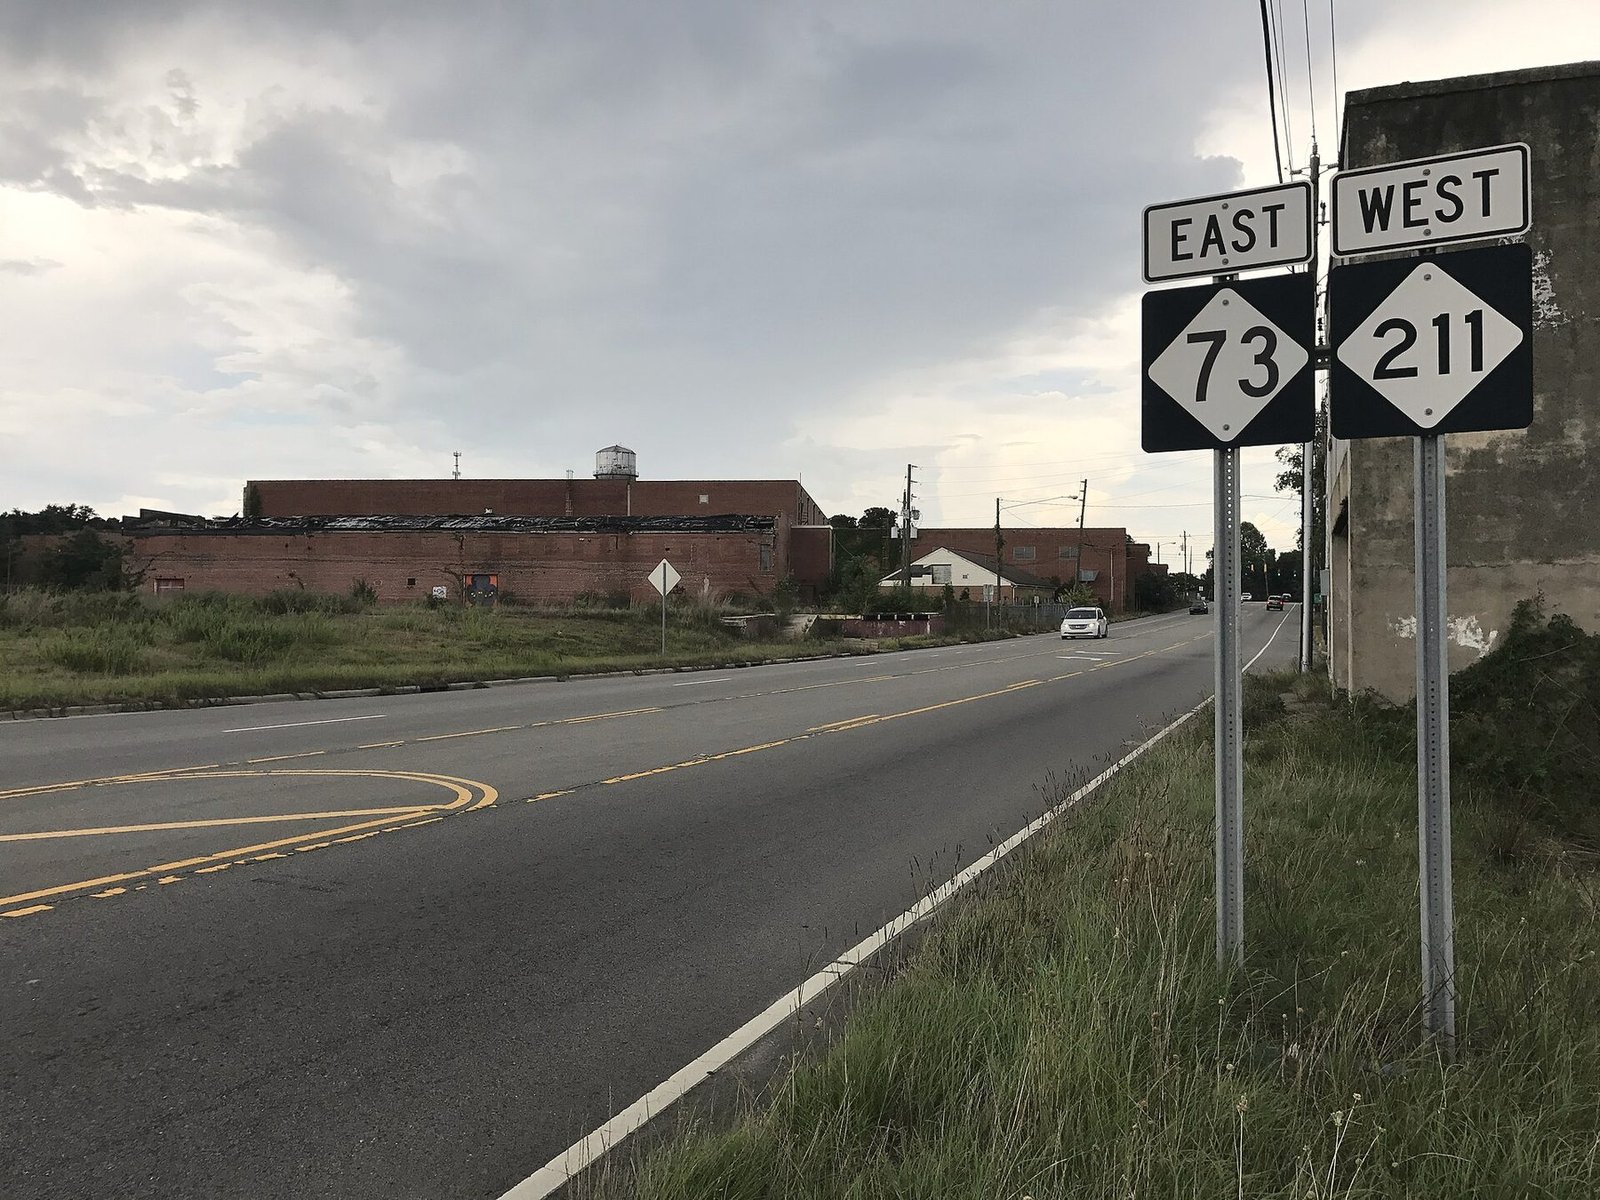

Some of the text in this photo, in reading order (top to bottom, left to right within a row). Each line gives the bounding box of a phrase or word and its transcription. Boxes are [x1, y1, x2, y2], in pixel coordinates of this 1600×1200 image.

[1171, 204, 1285, 262] EAST
[1358, 169, 1500, 233] WEST
[1187, 326, 1280, 402] 73
[1372, 309, 1484, 380] 211
